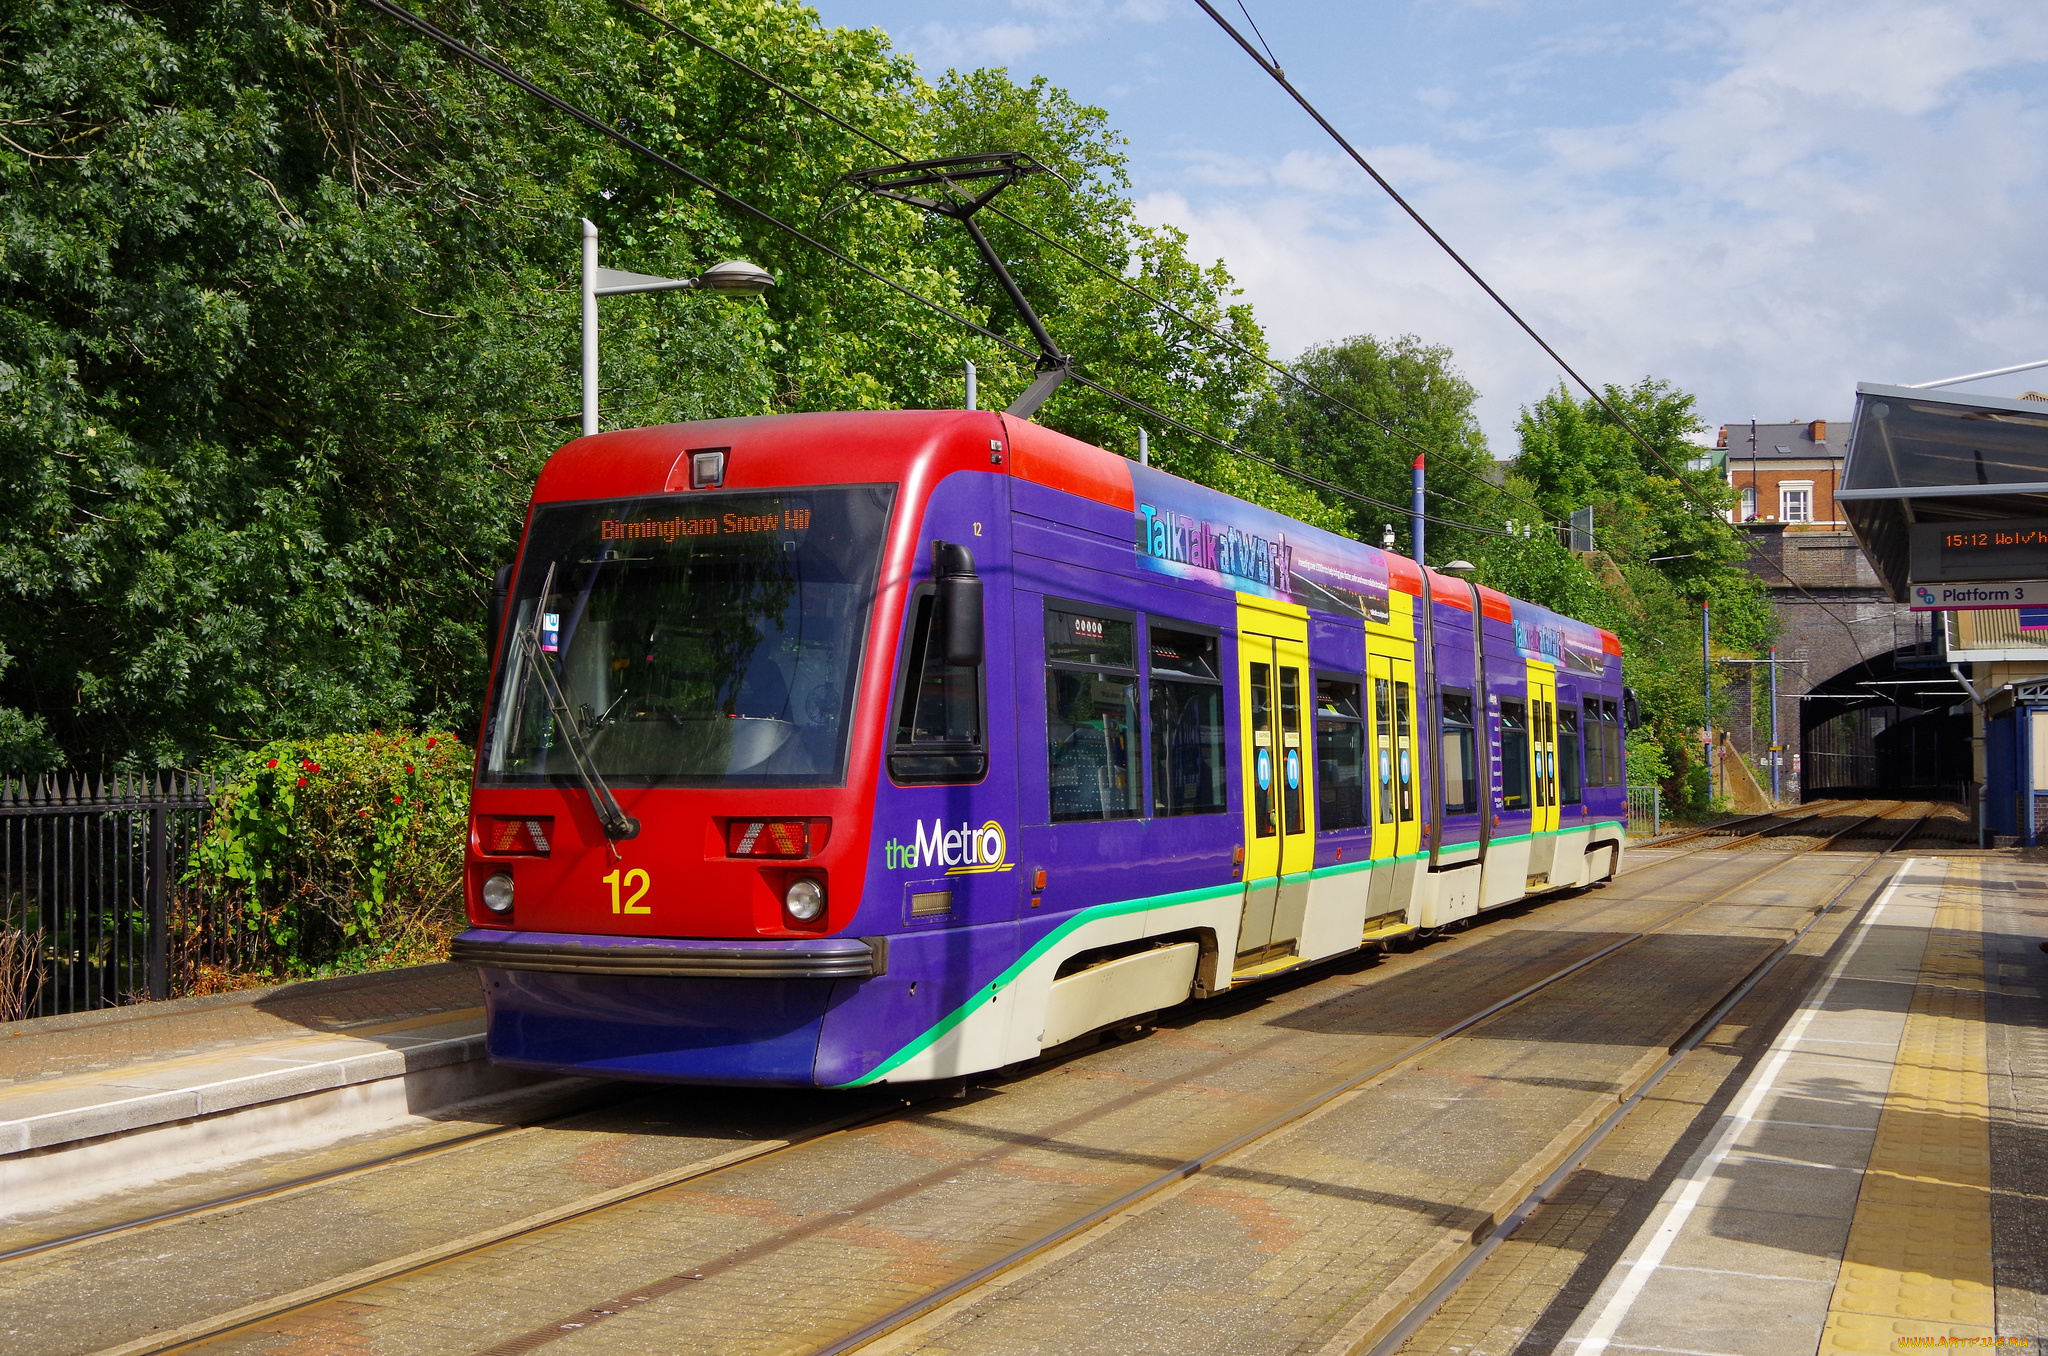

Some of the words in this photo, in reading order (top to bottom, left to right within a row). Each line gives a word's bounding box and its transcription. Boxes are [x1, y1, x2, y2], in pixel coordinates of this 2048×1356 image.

[601, 516, 718, 542] Birmingham
[723, 513, 779, 534] Snow
[972, 522, 982, 537] 12
[1946, 533, 1988, 547] 15:12
[1942, 587, 2010, 601] Platform
[2014, 587, 2024, 600] 3
[602, 868, 651, 914] 12
